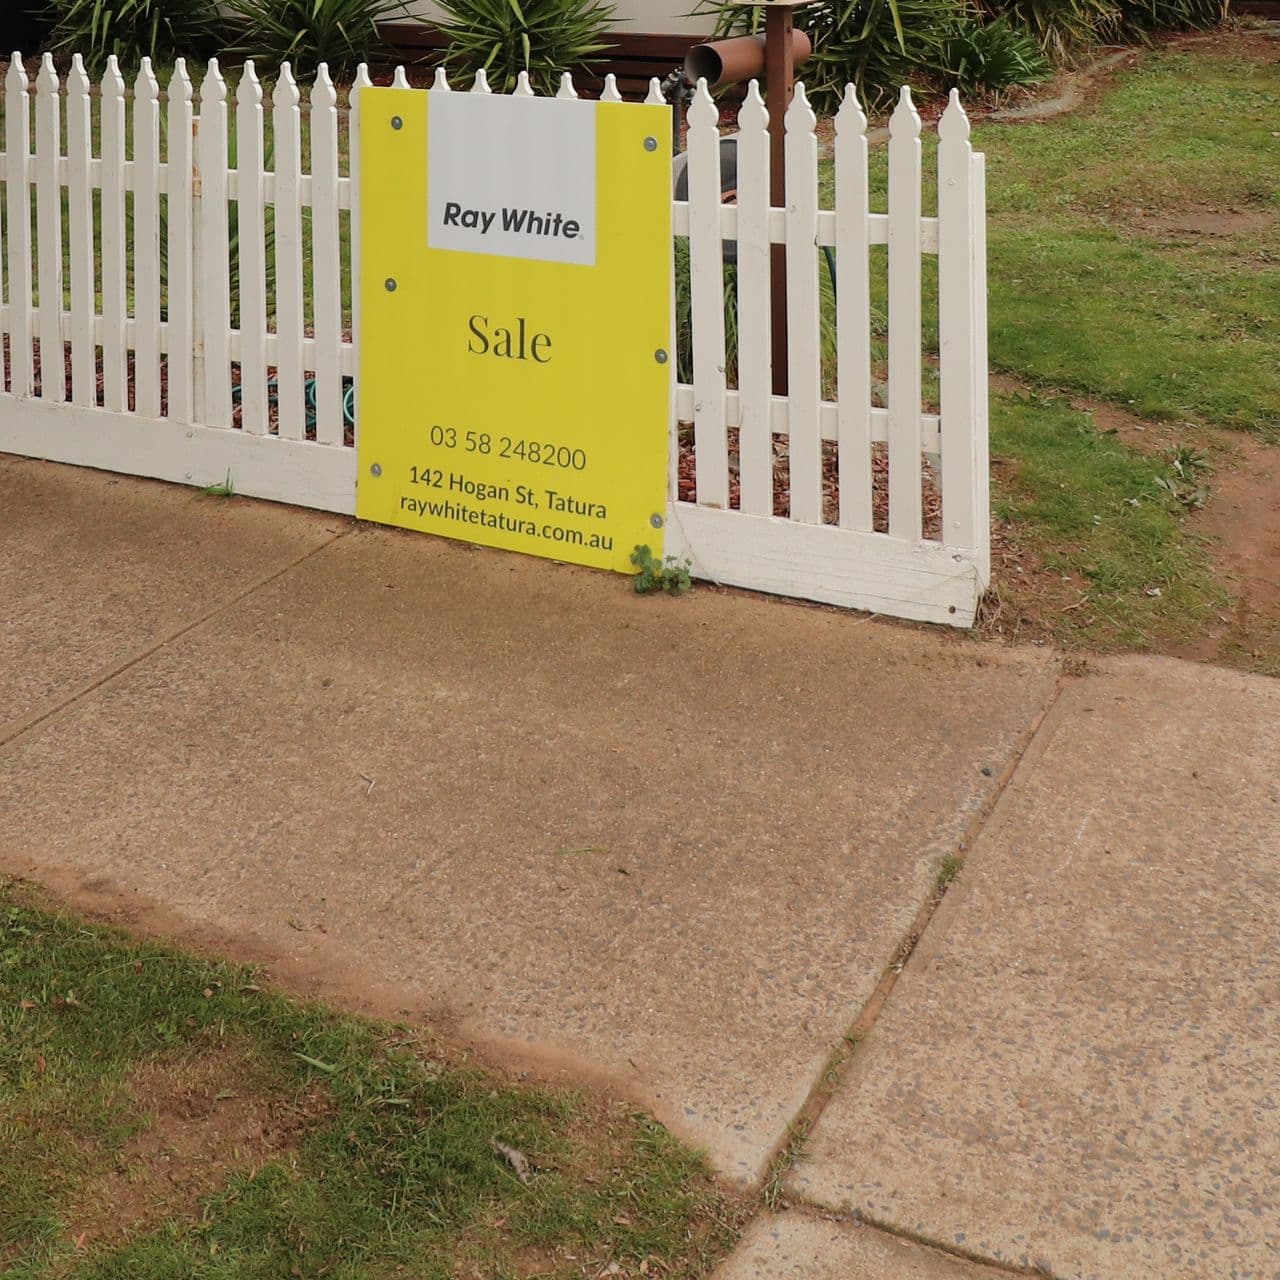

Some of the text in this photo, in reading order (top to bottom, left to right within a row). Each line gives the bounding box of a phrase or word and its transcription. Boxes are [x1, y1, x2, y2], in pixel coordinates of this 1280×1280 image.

[443, 202, 581, 239] Ray White
[467, 314, 552, 363] Sale
[430, 425, 586, 471] 03 58 248200
[410, 466, 607, 520] 142 Hogan St, Tatura
[400, 495, 613, 551] raywhitetatura.com.au
